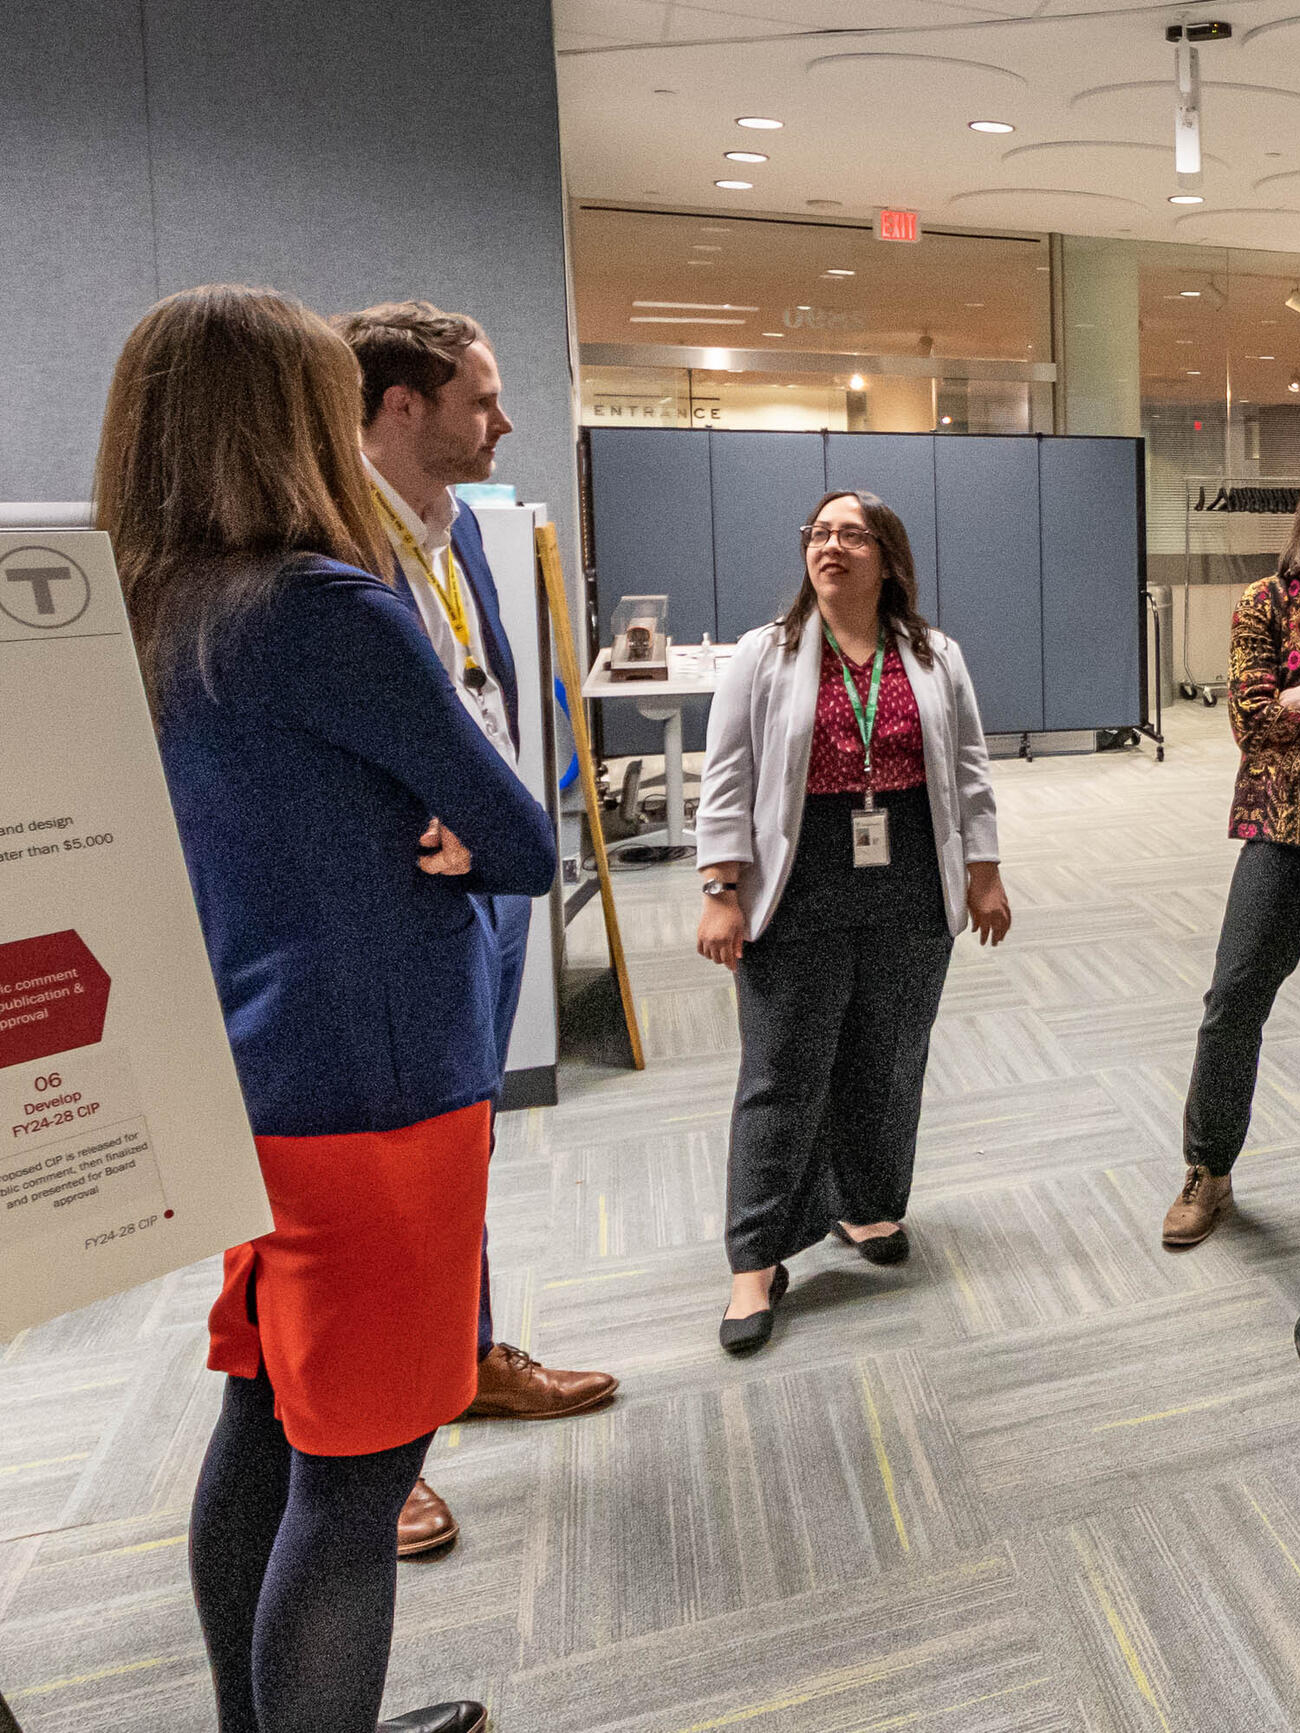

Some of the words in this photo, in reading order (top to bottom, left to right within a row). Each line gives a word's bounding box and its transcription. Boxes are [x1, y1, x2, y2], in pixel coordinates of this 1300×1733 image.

[881, 211, 917, 240] EXIT
[593, 405, 720, 419] ENTRANCE
[5, 567, 71, 614] T
[0, 823, 24, 836] and
[28, 817, 73, 831] design
[28, 844, 60, 857] than
[15, 968, 80, 991] comment
[74, 983, 84, 993] &
[34, 1072, 62, 1092] 06
[24, 1092, 82, 1115] Develop
[12, 1110, 74, 1137] FY24-28
[77, 1102, 100, 1117] CIP
[0, 1162, 42, 1182] oposed
[45, 1155, 63, 1168] CIP
[65, 1152, 75, 1162] is
[77, 1137, 122, 1158] released
[124, 1132, 139, 1143] for
[79, 1157, 104, 1171] then
[106, 1142, 148, 1162] finalized
[7, 1195, 28, 1210] and
[31, 1176, 86, 1202] presented
[88, 1170, 103, 1182] for
[105, 1159, 136, 1176] Board
[53, 1185, 99, 1208] approval
[85, 1223, 136, 1250] FY24-28
[138, 1215, 158, 1230] CIP
